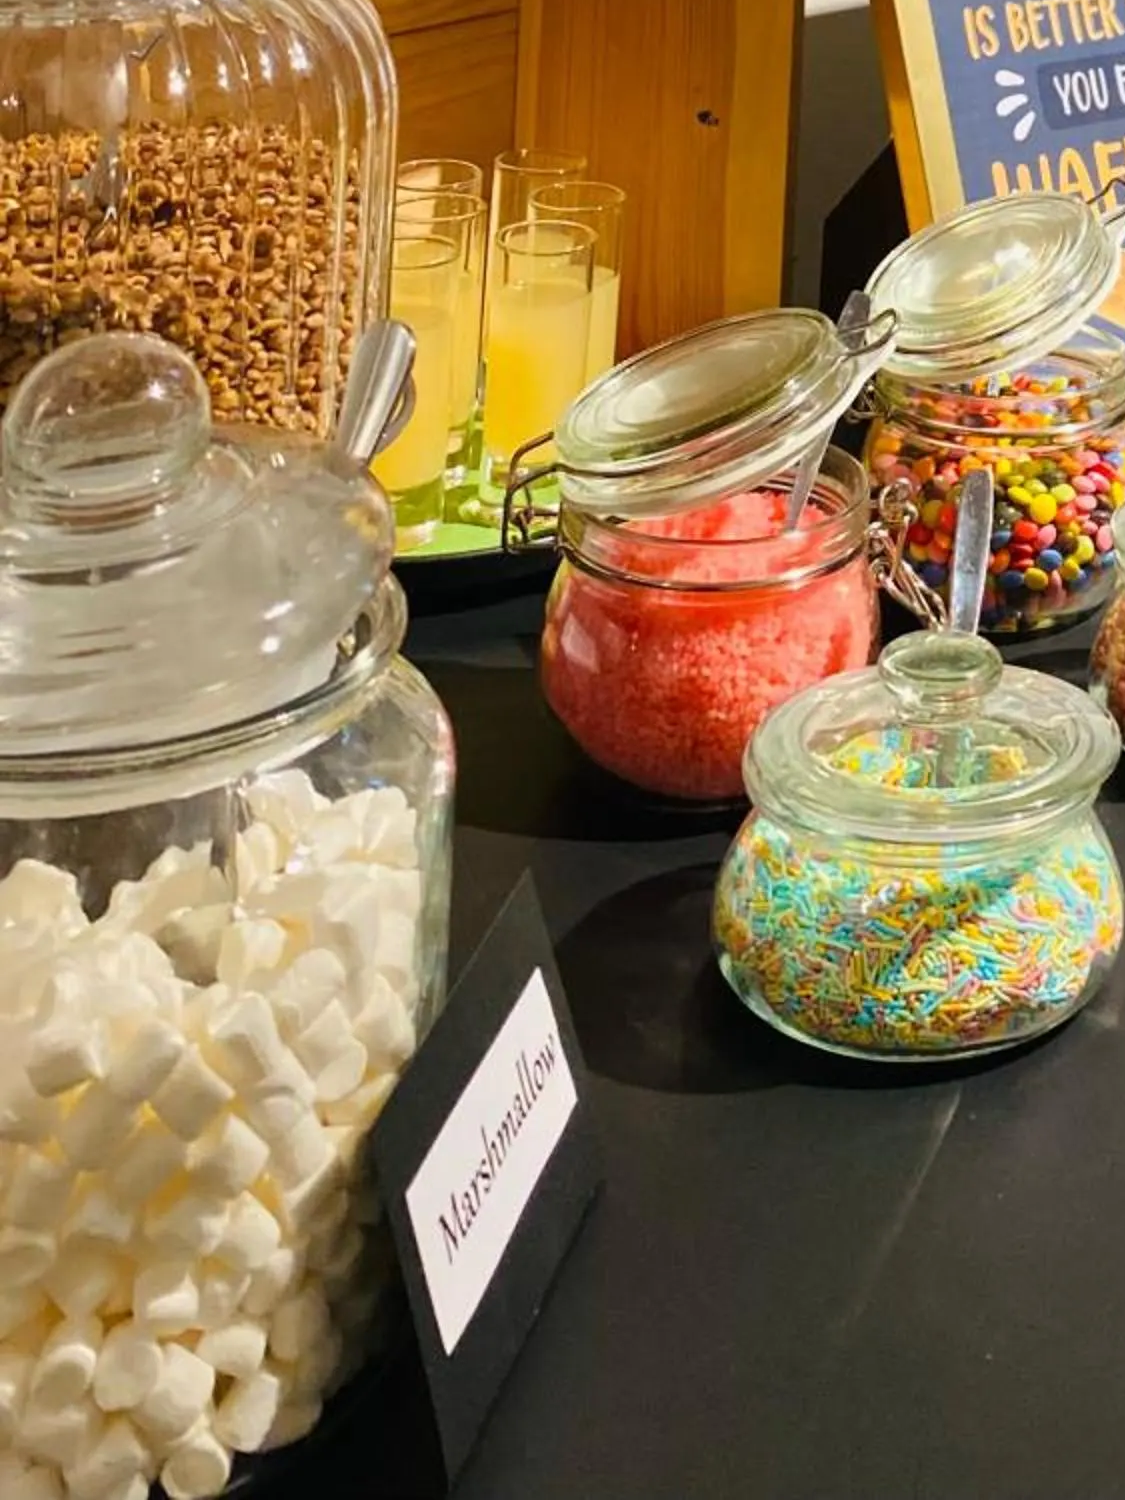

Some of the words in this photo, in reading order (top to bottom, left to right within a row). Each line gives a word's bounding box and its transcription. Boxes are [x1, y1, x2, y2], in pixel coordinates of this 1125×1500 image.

[963, 4, 1000, 61] IS
[1052, 68, 1109, 118] YOU
[437, 1031, 557, 1267] Marshmallow
